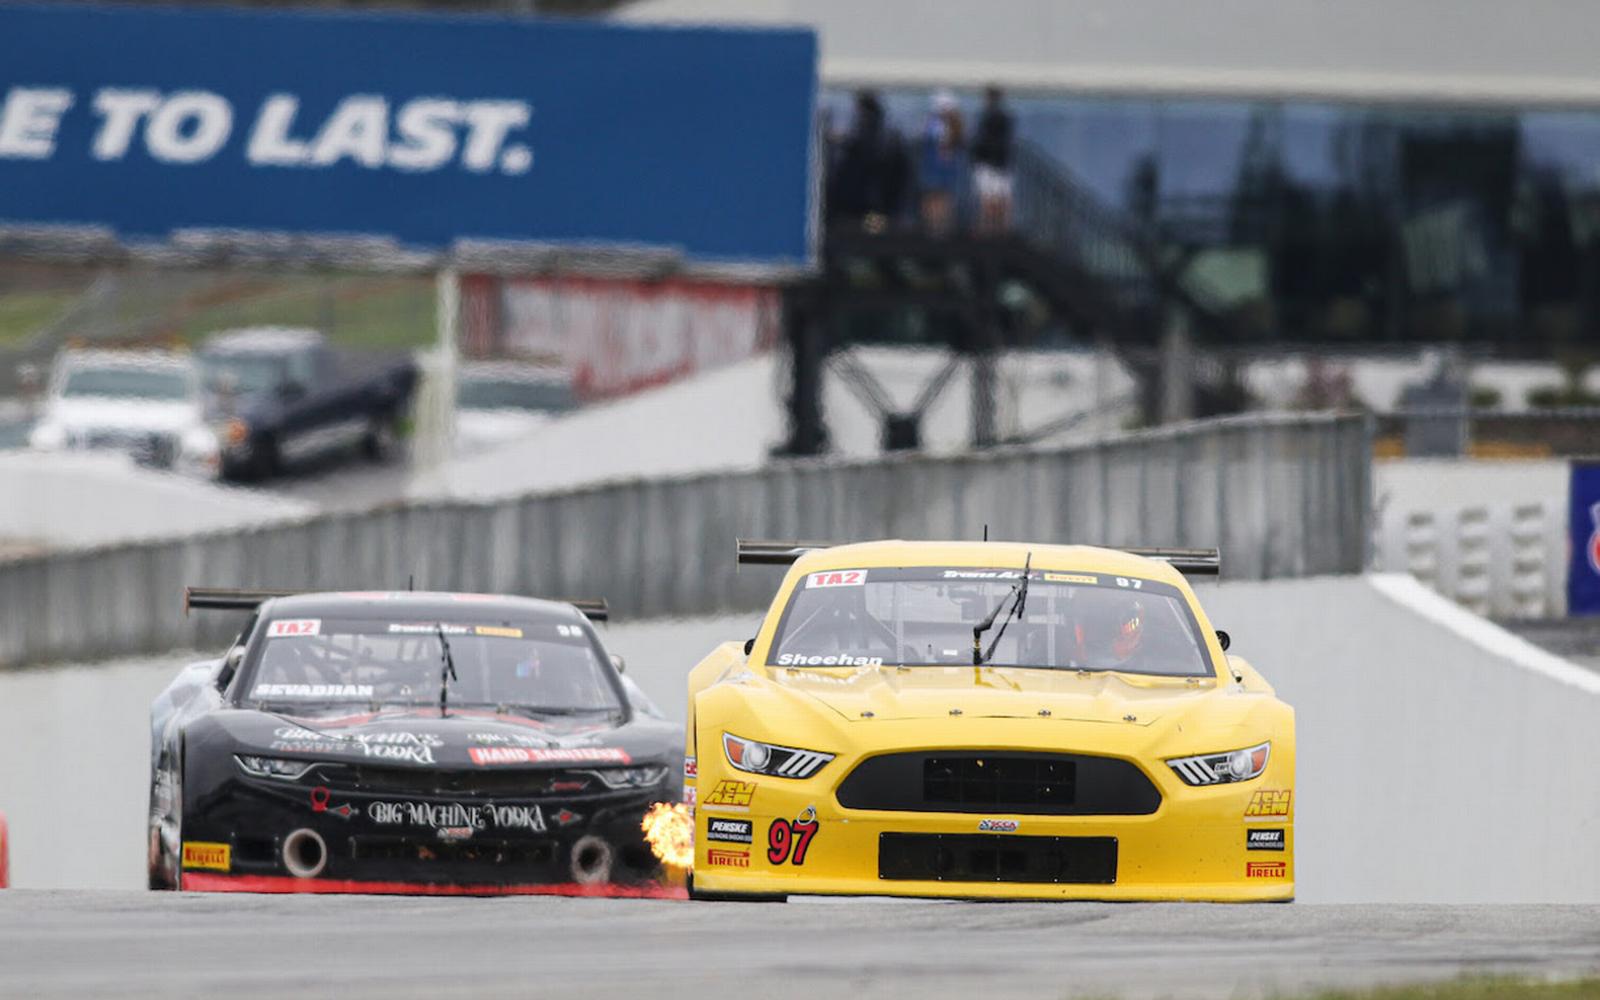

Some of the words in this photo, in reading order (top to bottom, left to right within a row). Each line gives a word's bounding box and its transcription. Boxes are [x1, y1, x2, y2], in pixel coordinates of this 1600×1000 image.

[92, 89, 233, 162] TO
[246, 93, 533, 174] LAST.
[815, 572, 860, 585] TA2
[1116, 577, 1142, 589] 97
[276, 621, 315, 634] TA2
[778, 653, 882, 667] Sheehan
[703, 780, 757, 807] AEM
[1244, 790, 1291, 816] AEM
[368, 801, 402, 824] BIG
[403, 802, 485, 829] MACHINE
[485, 803, 547, 832] VODKA
[711, 821, 748, 833] PENSKE
[767, 818, 819, 866] 97
[708, 848, 750, 868] PIRELLI
[1247, 861, 1286, 877] PIRELLI
